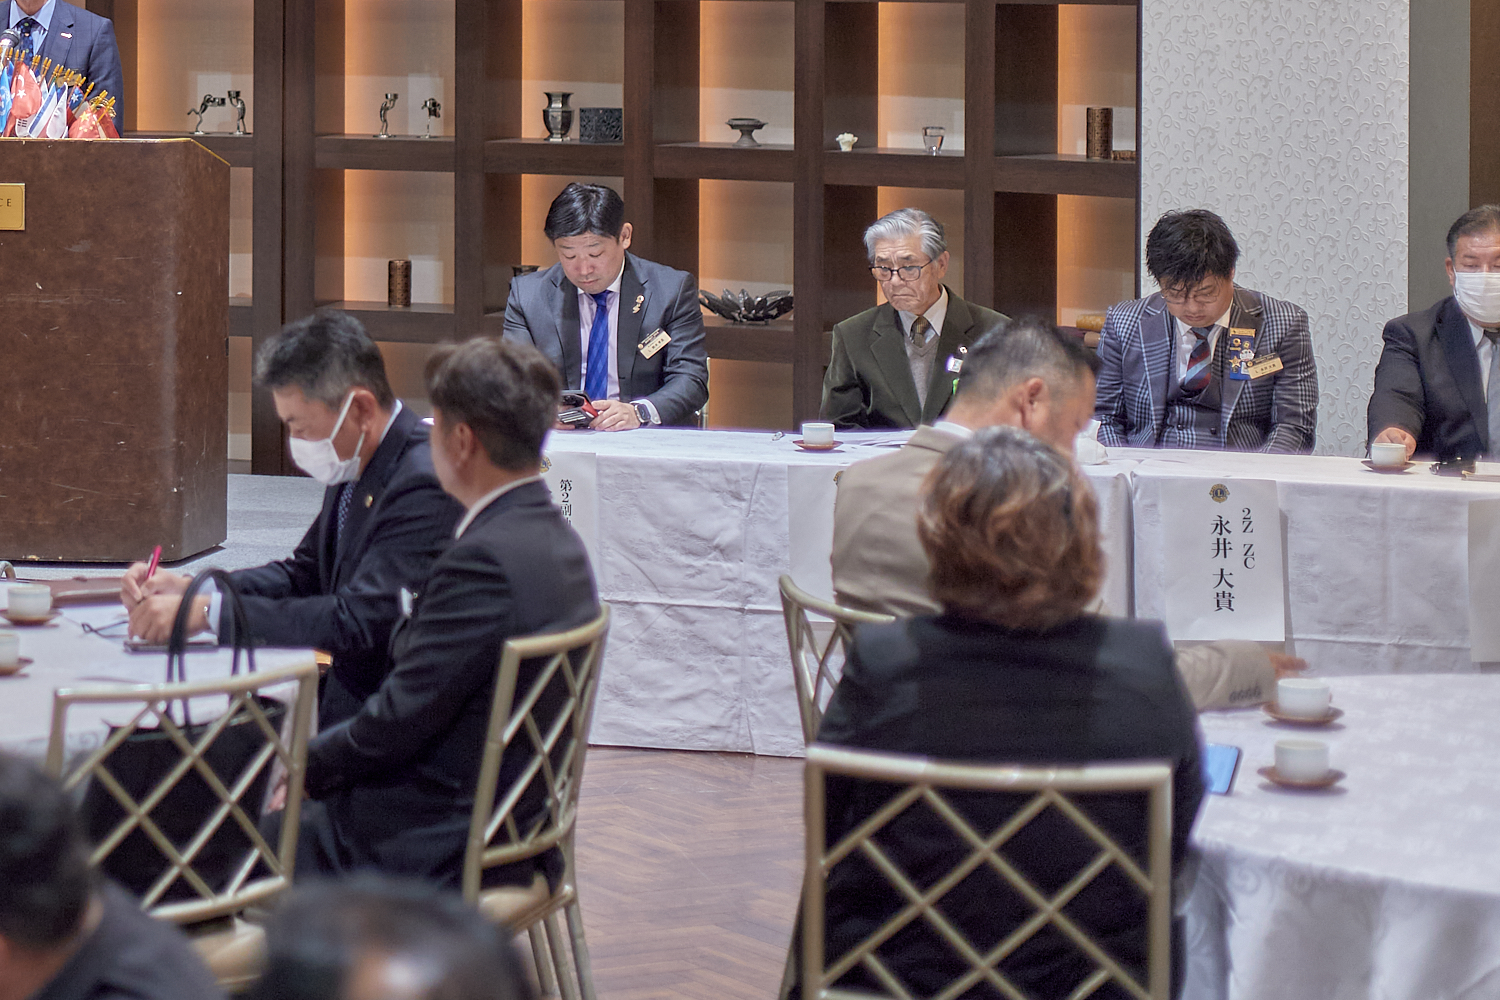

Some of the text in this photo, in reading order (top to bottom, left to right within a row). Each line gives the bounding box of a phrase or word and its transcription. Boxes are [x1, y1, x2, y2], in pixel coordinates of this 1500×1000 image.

[1210, 514, 1236, 612] 永井 大貴
[1242, 507, 1256, 570] 2Z ZC
